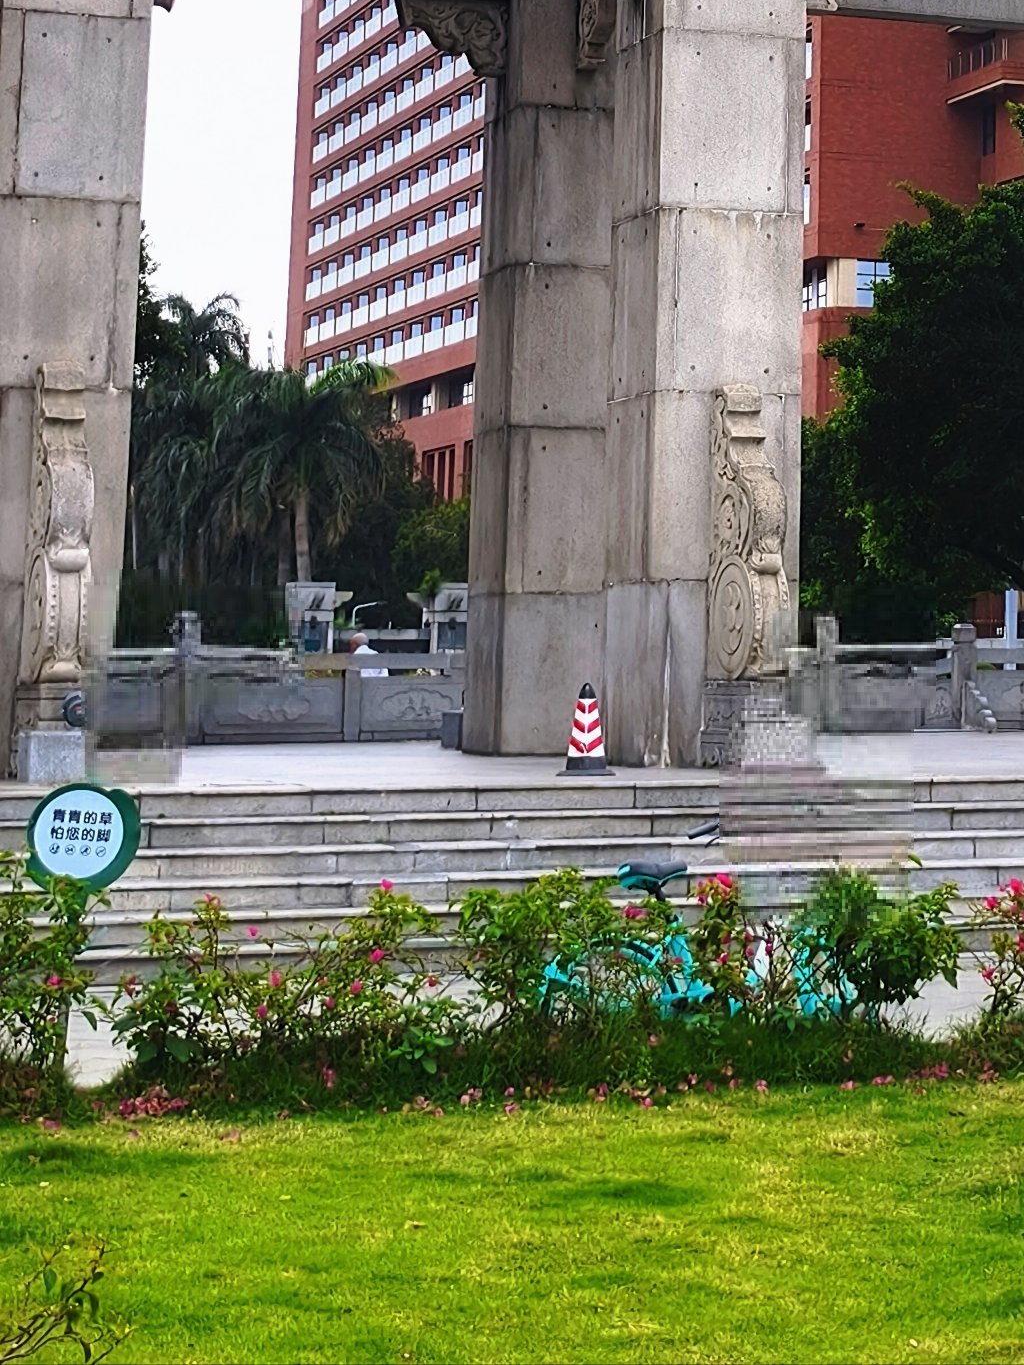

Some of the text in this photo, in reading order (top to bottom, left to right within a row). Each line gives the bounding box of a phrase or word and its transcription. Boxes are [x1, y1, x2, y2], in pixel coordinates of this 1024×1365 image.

[52, 808, 113, 825] 青青的草
[50, 825, 111, 842] 怕您的脚
